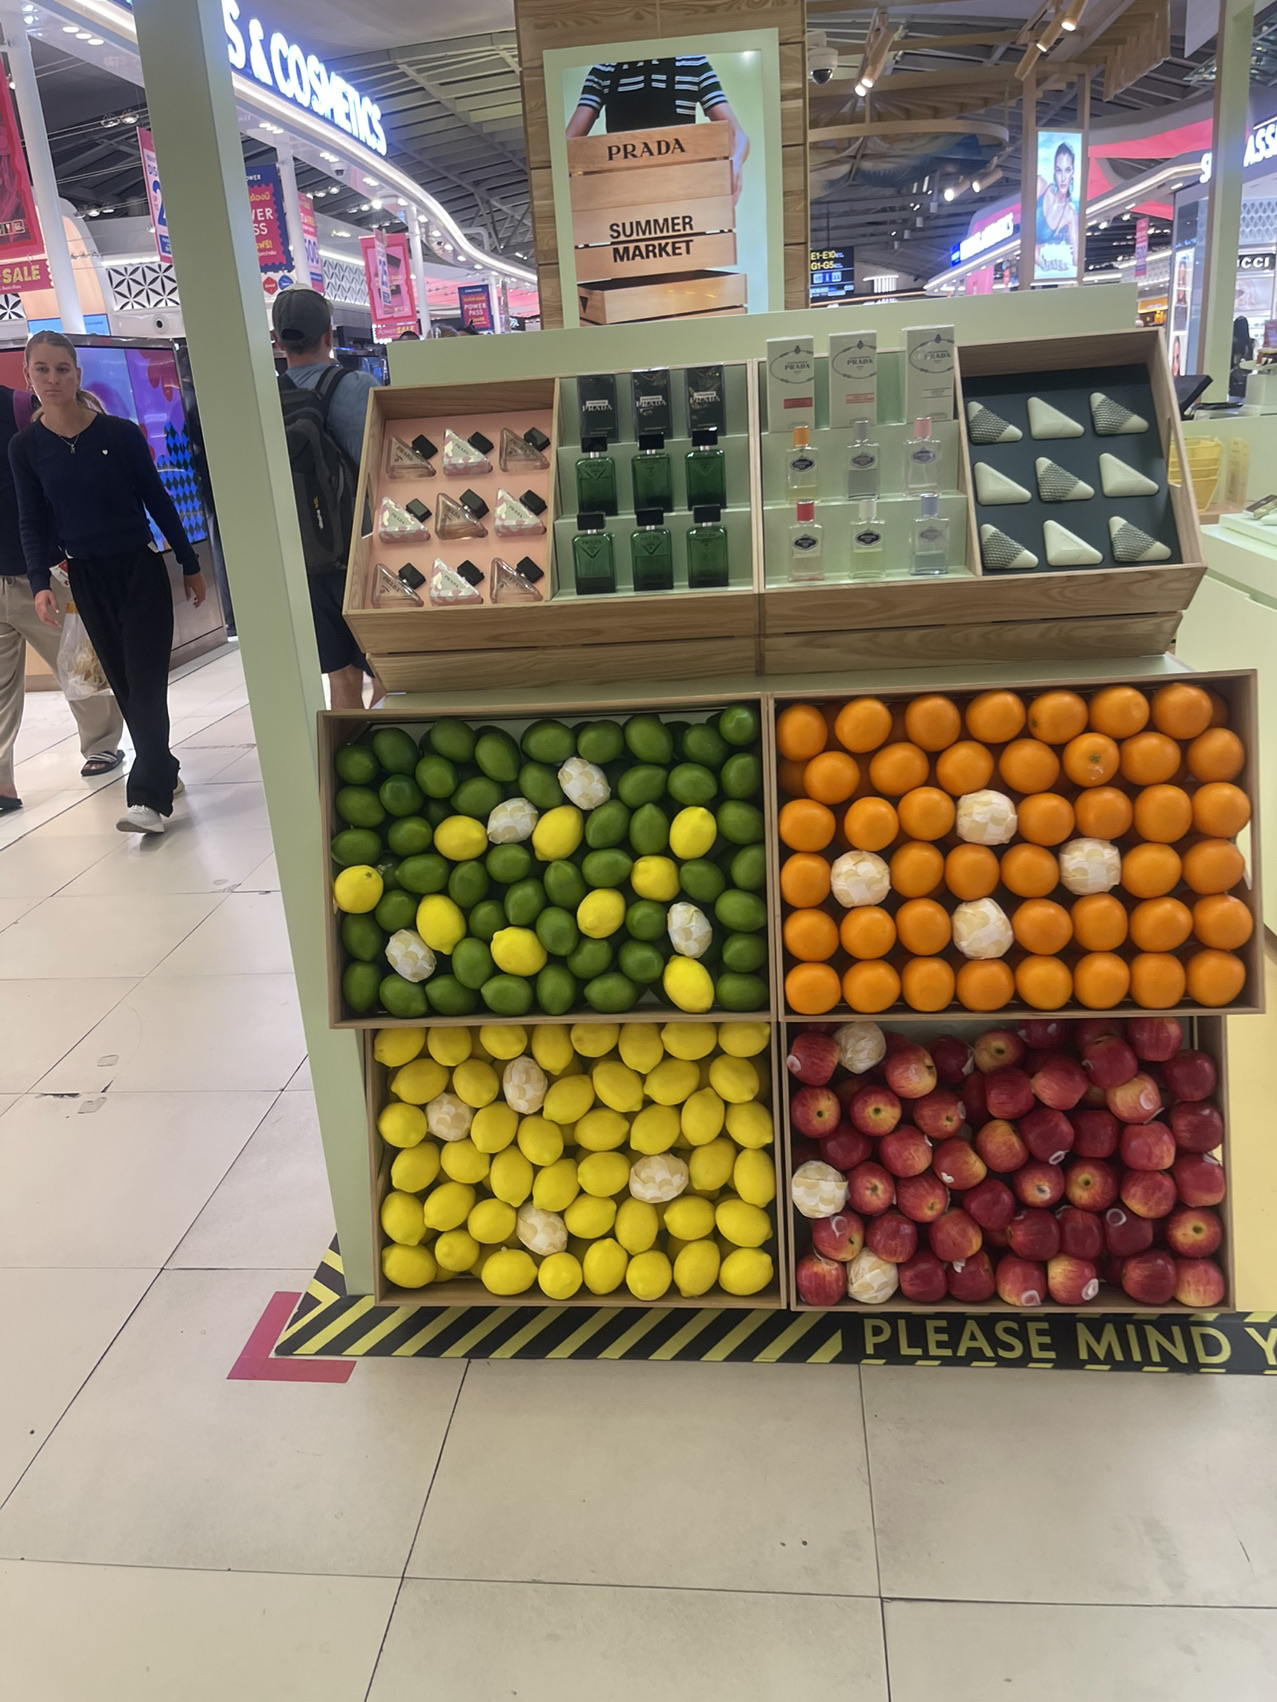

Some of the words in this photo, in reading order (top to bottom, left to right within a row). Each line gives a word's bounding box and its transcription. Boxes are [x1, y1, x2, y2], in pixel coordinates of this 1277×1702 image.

[270, 32, 388, 156] COSMETICS
[607, 138, 686, 161] PRADA
[609, 215, 694, 240] SUMMER
[612, 239, 694, 263] MARKET
[2, 265, 41, 284] SALE
[784, 363, 811, 371] PRADA
[863, 1318, 1057, 1359] PLEASE
[1076, 1322, 1232, 1364] MIND
[1243, 1327, 1277, 1366] Y
